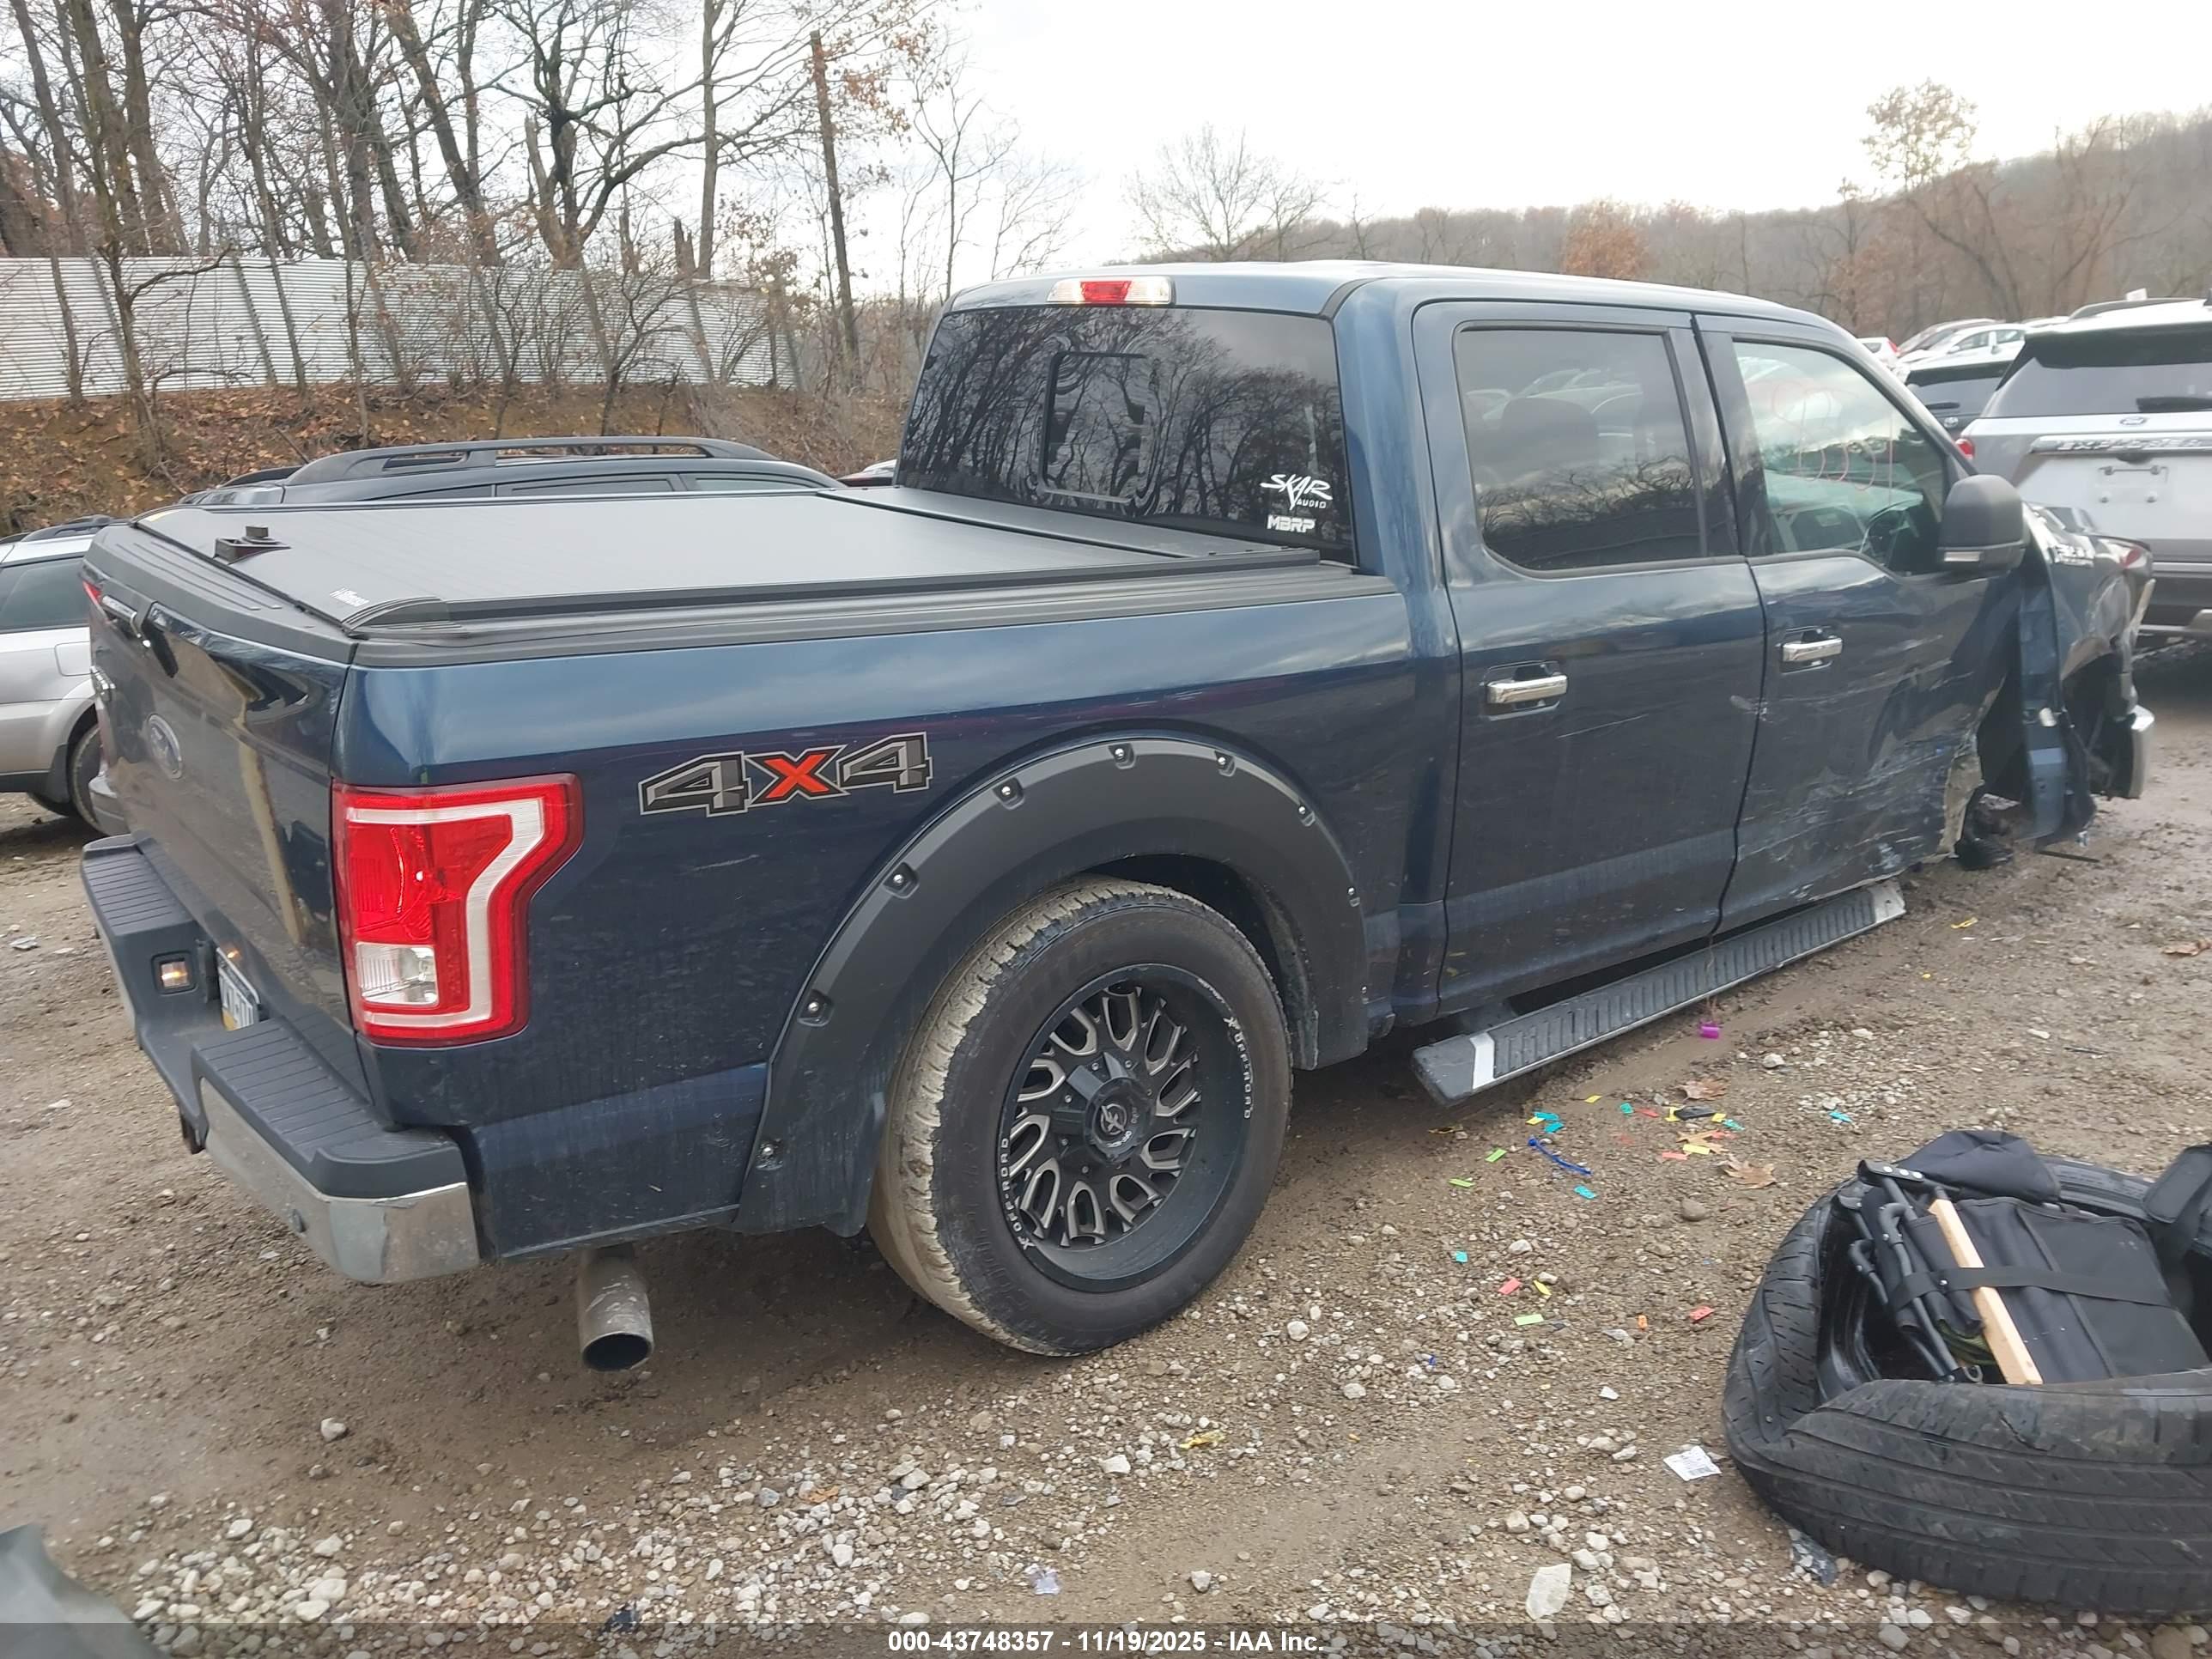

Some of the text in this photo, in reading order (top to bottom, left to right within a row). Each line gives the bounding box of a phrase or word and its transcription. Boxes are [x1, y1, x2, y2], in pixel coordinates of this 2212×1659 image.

[1260, 473, 1333, 511] SKAR
[1296, 499, 1327, 509] AUDIO
[1267, 514, 1316, 533] MBRP
[1000, 1138, 1023, 1232] OFF-ROAD
